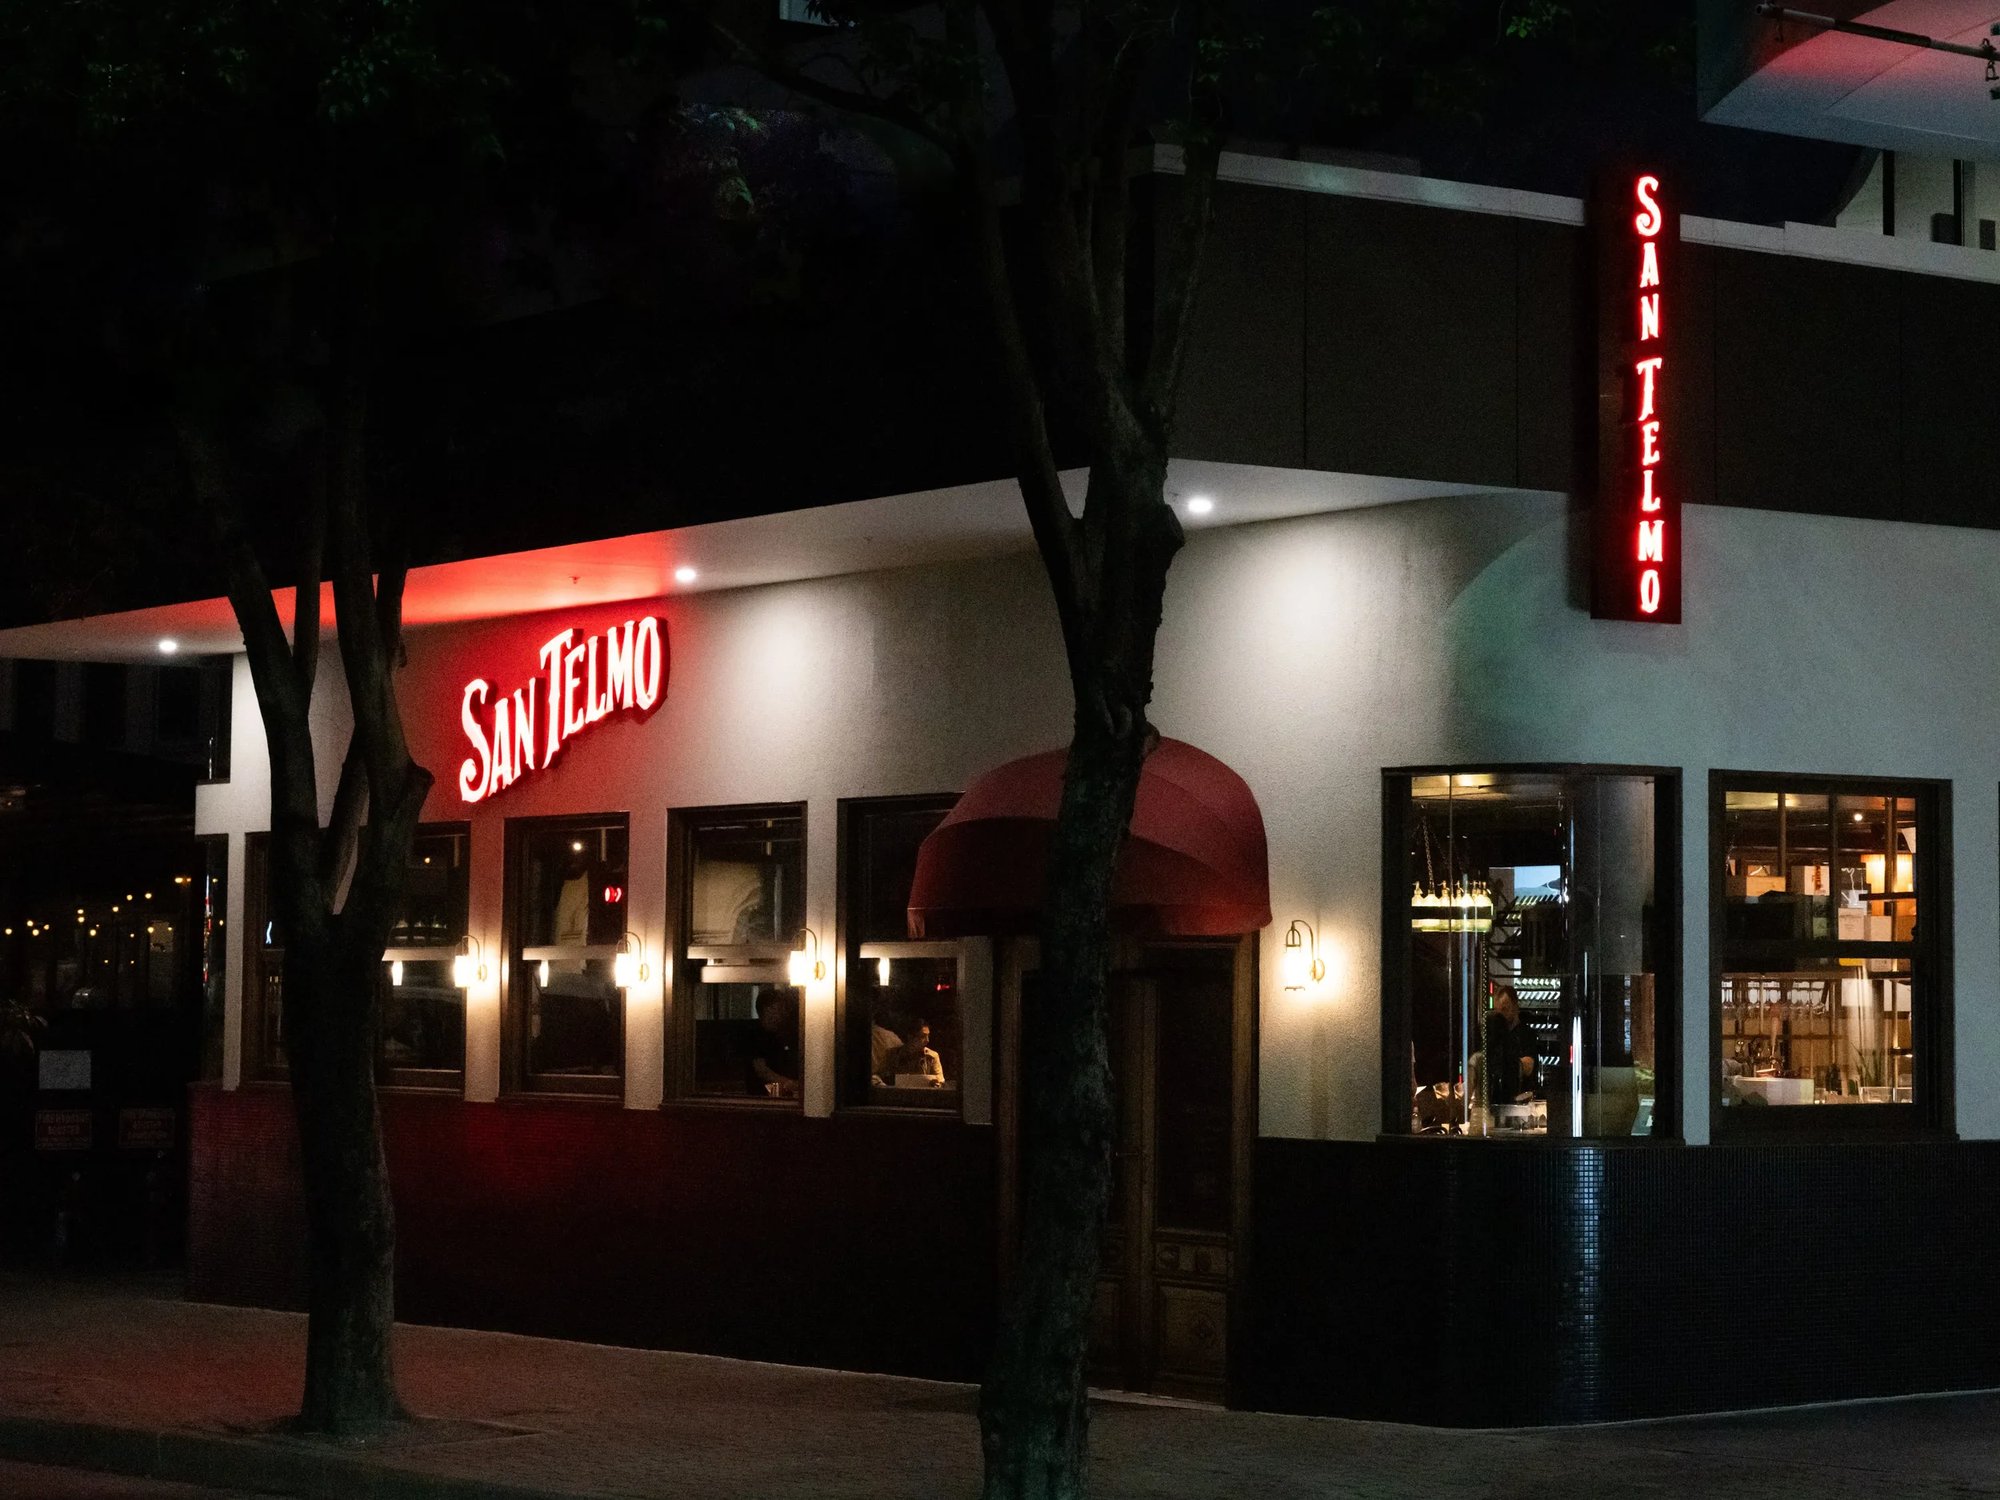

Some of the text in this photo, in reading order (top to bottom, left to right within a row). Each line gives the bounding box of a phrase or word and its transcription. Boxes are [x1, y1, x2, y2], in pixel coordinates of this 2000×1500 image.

[1635, 175, 1665, 614] SAN TELMO
[458, 615, 662, 804] SAN TELMO
